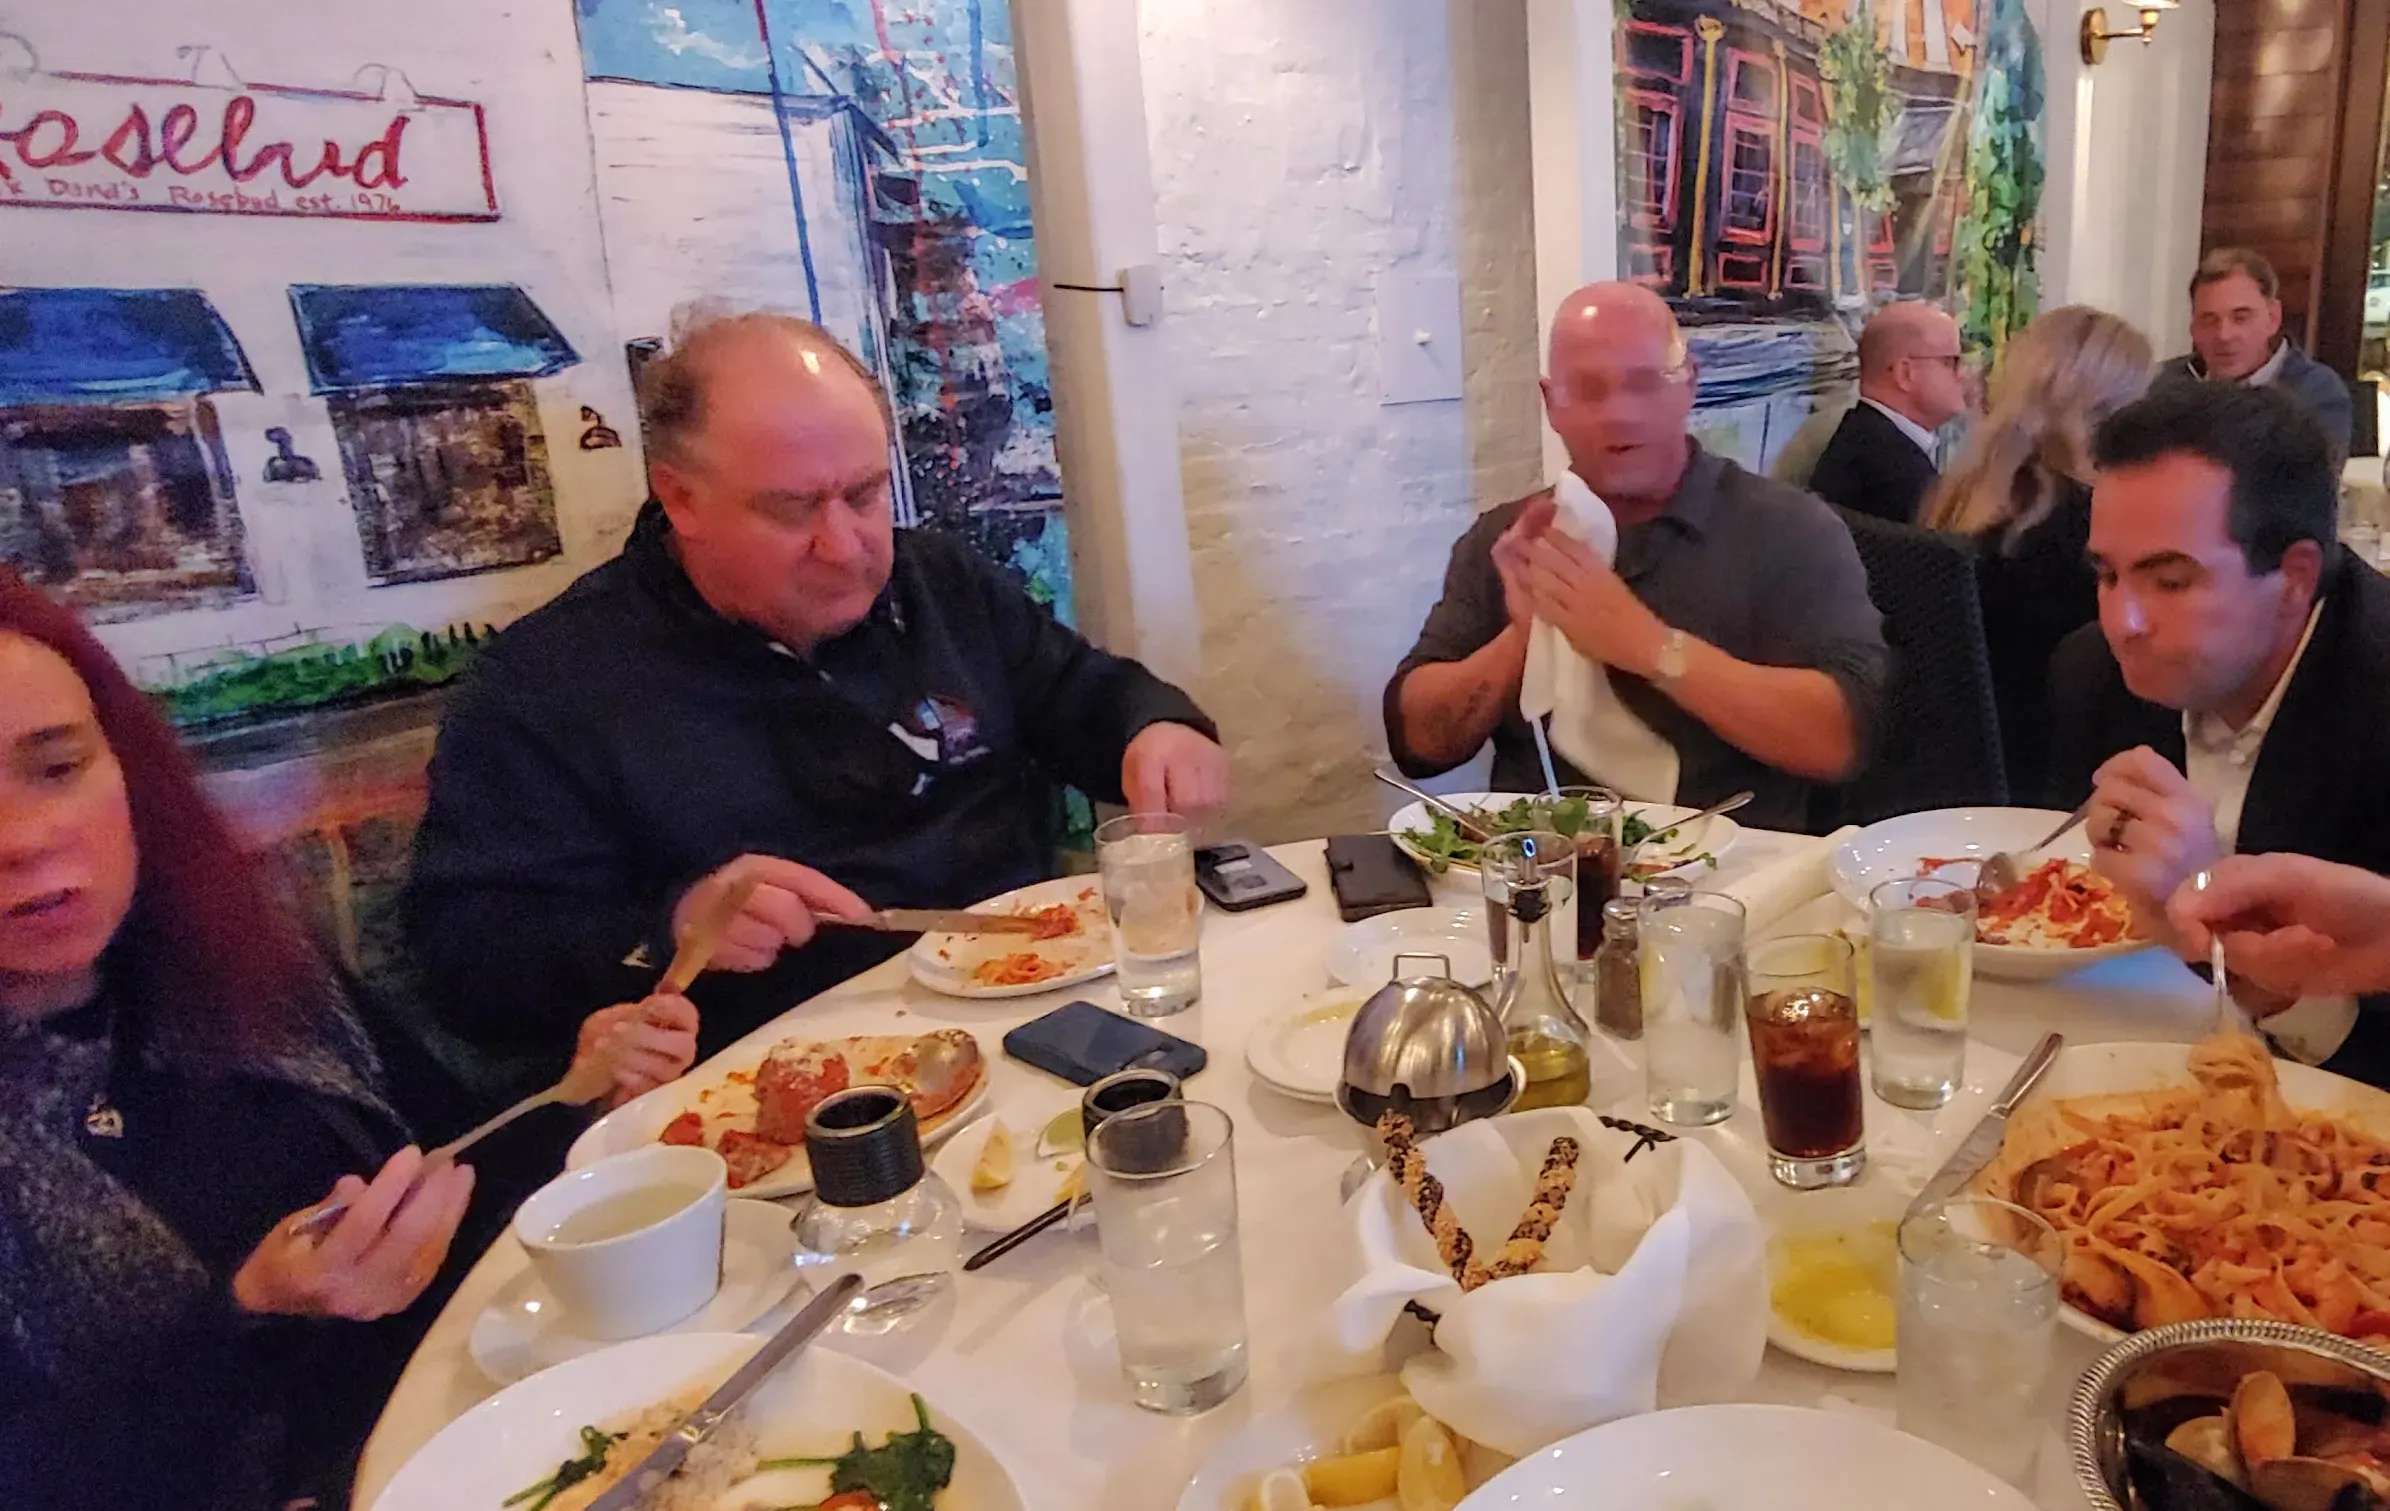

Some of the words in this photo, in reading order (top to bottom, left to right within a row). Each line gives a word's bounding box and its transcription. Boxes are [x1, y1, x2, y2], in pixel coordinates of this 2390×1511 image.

[0, 96, 408, 189] osebud
[168, 183, 280, 210] Rosebud
[296, 193, 341, 212] est.
